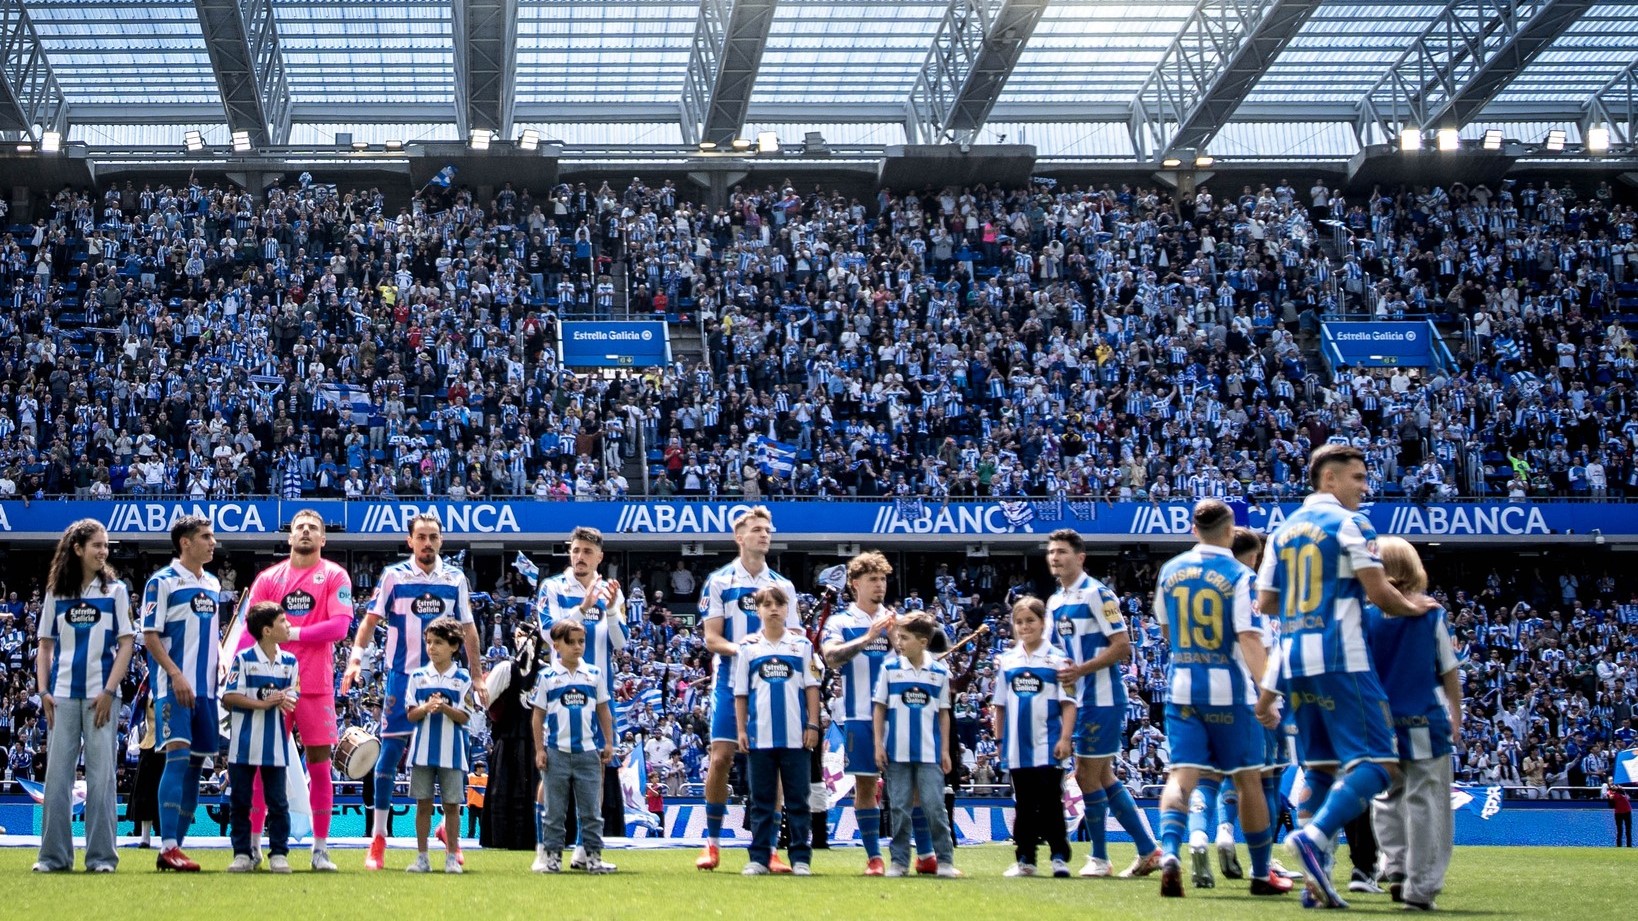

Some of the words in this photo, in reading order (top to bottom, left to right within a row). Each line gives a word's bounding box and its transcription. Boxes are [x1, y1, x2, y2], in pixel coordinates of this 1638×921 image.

[573, 330, 608, 340] Estrella
[608, 330, 640, 340] Galicia
[1336, 331, 1371, 341] Estrella
[1372, 331, 1404, 341] Galicia
[1280, 544, 1323, 617] 10
[286, 595, 311, 603] Estrella
[416, 599, 441, 607] Estrella
[417, 606, 440, 614] Galicia
[70, 615, 95, 623] Galicia
[1172, 586, 1224, 650] 19
[762, 663, 789, 671] Estrella
[764, 670, 788, 678] Galicia
[1013, 676, 1040, 685] Estrella
